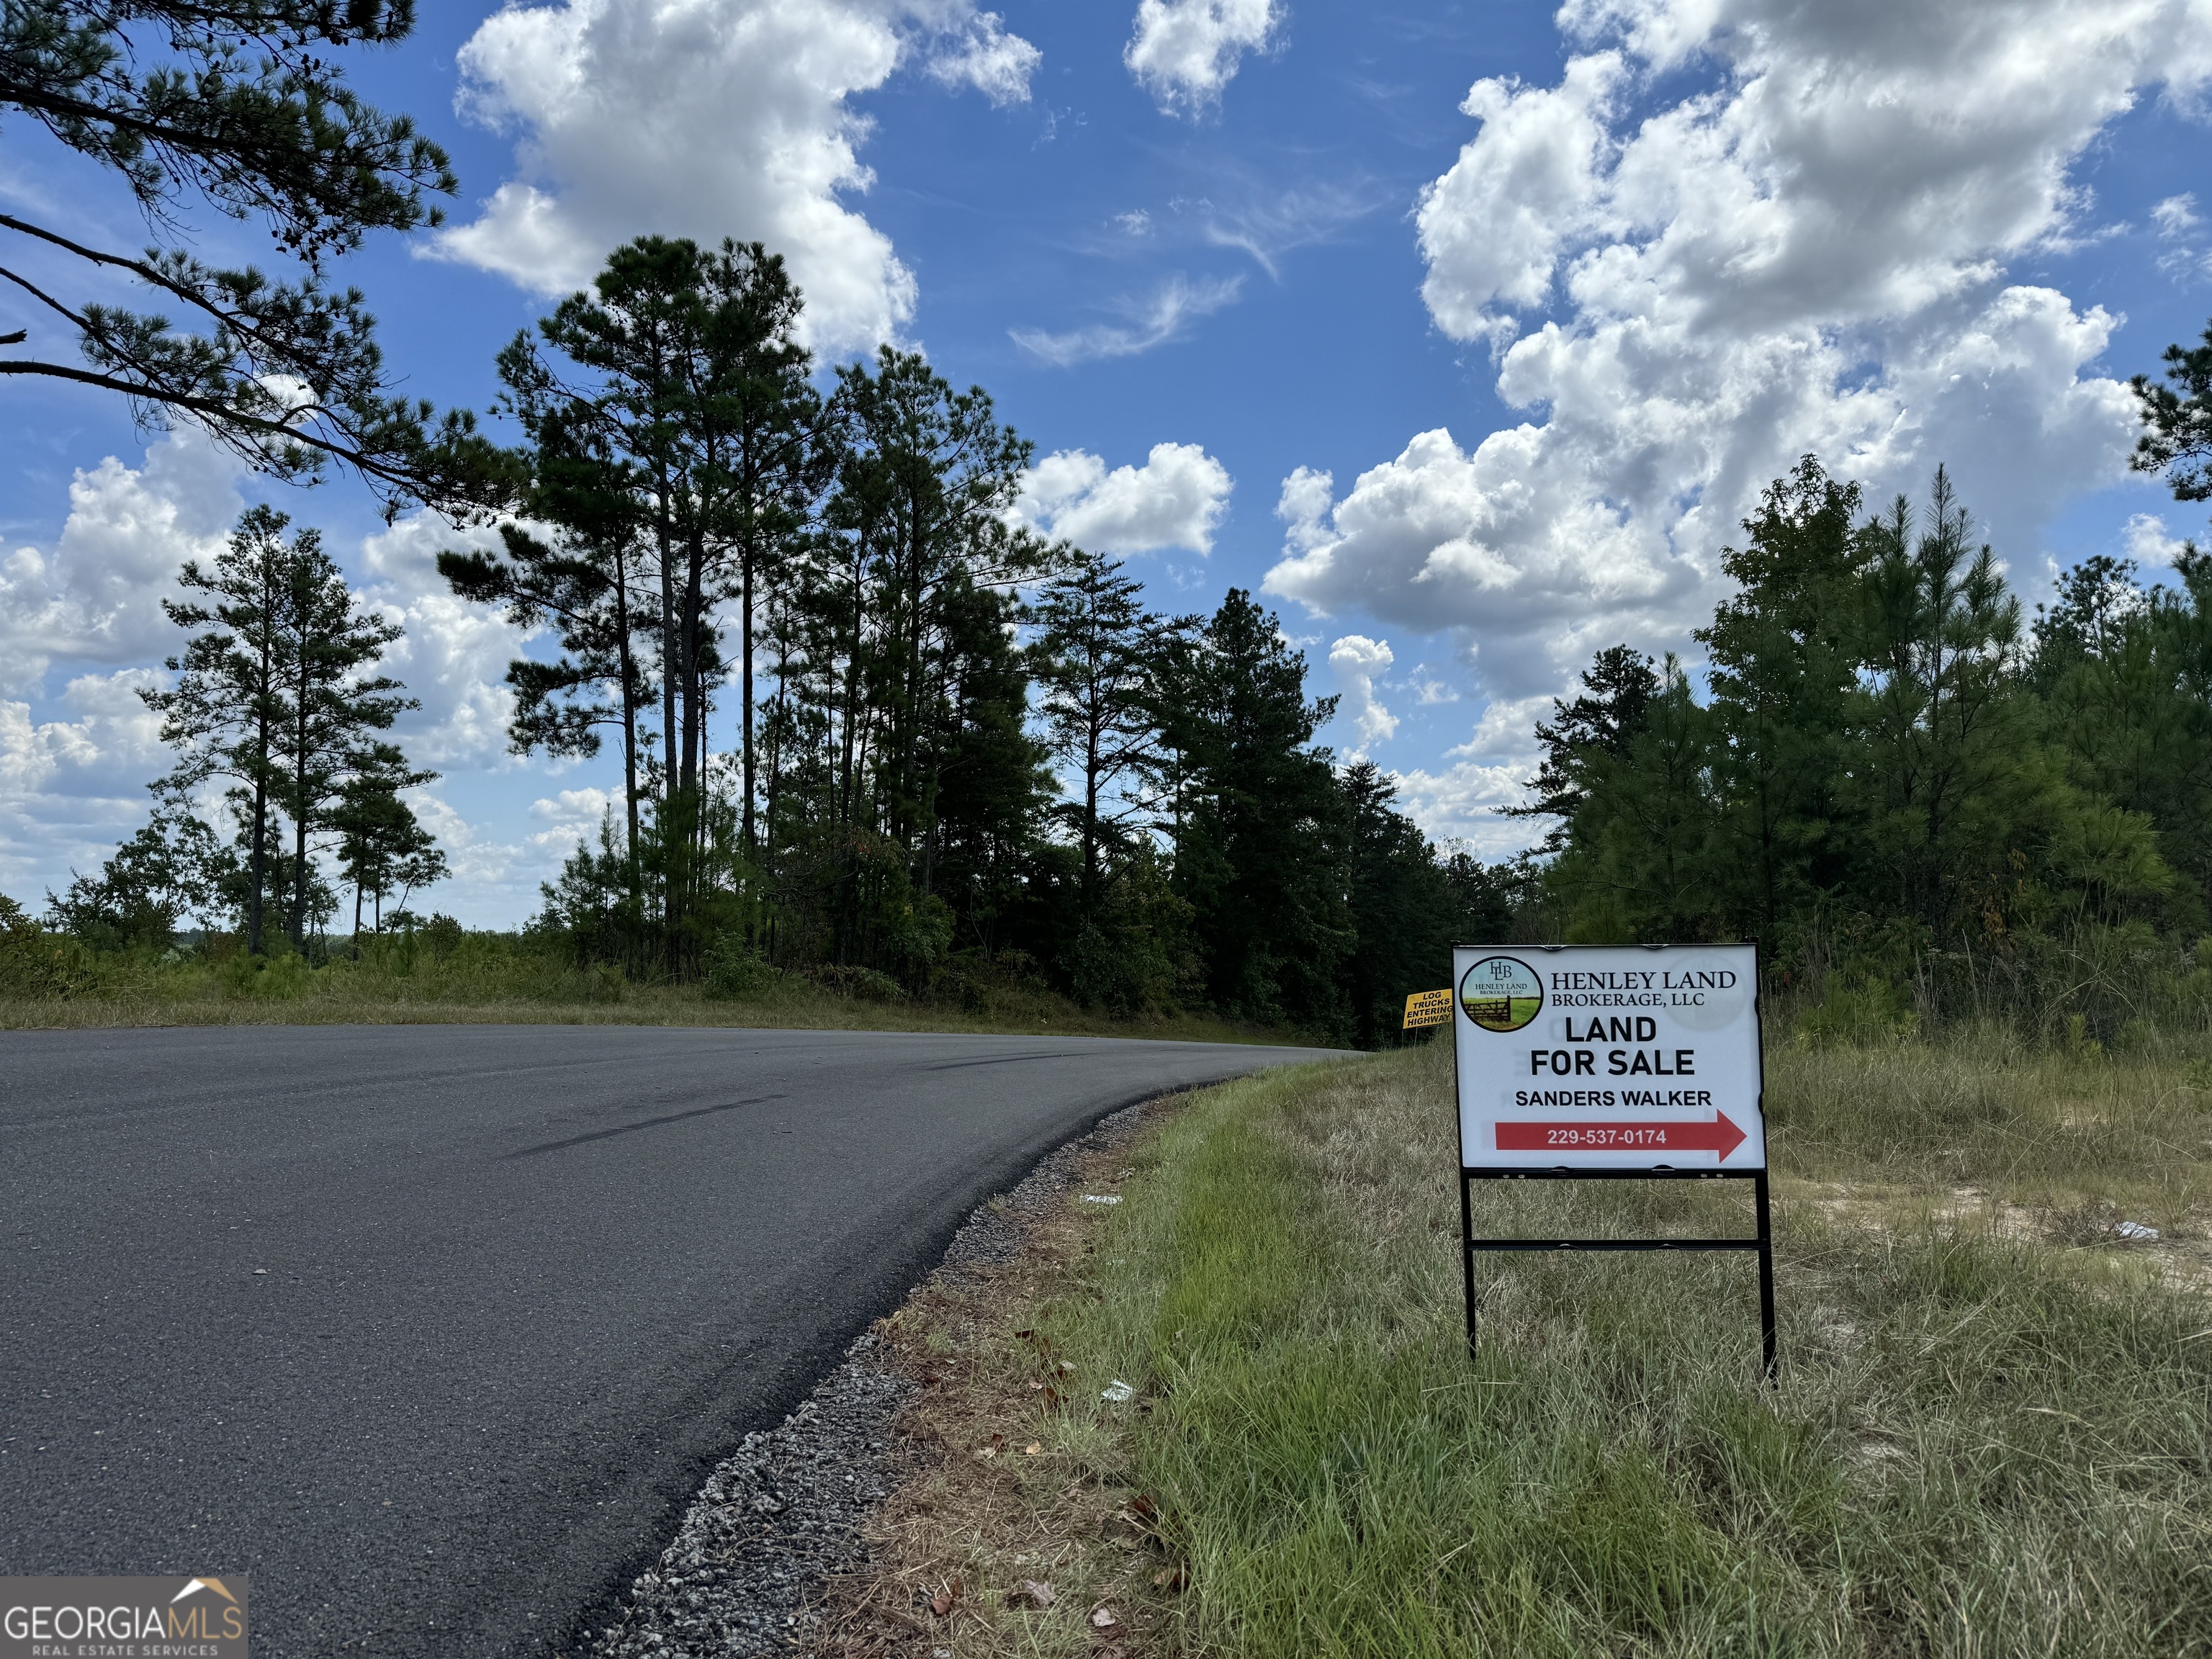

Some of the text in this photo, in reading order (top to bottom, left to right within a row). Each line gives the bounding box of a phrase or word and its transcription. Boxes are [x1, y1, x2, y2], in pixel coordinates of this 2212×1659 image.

[1551, 971, 1737, 990] HENLEY LAND
[1413, 998, 1450, 1010] TRUCKS
[1552, 993, 1705, 1007] BROKERAGE, LLC
[1407, 1006, 1453, 1018] ENTERING
[1407, 1014, 1450, 1026] HIGHWAY
[1565, 1017, 1656, 1042] LAND
[1531, 1050, 1695, 1076] FOR SALE
[1515, 1091, 1712, 1107] SANDERS WALKER
[1547, 1130, 1666, 1144] 229-537-0174
